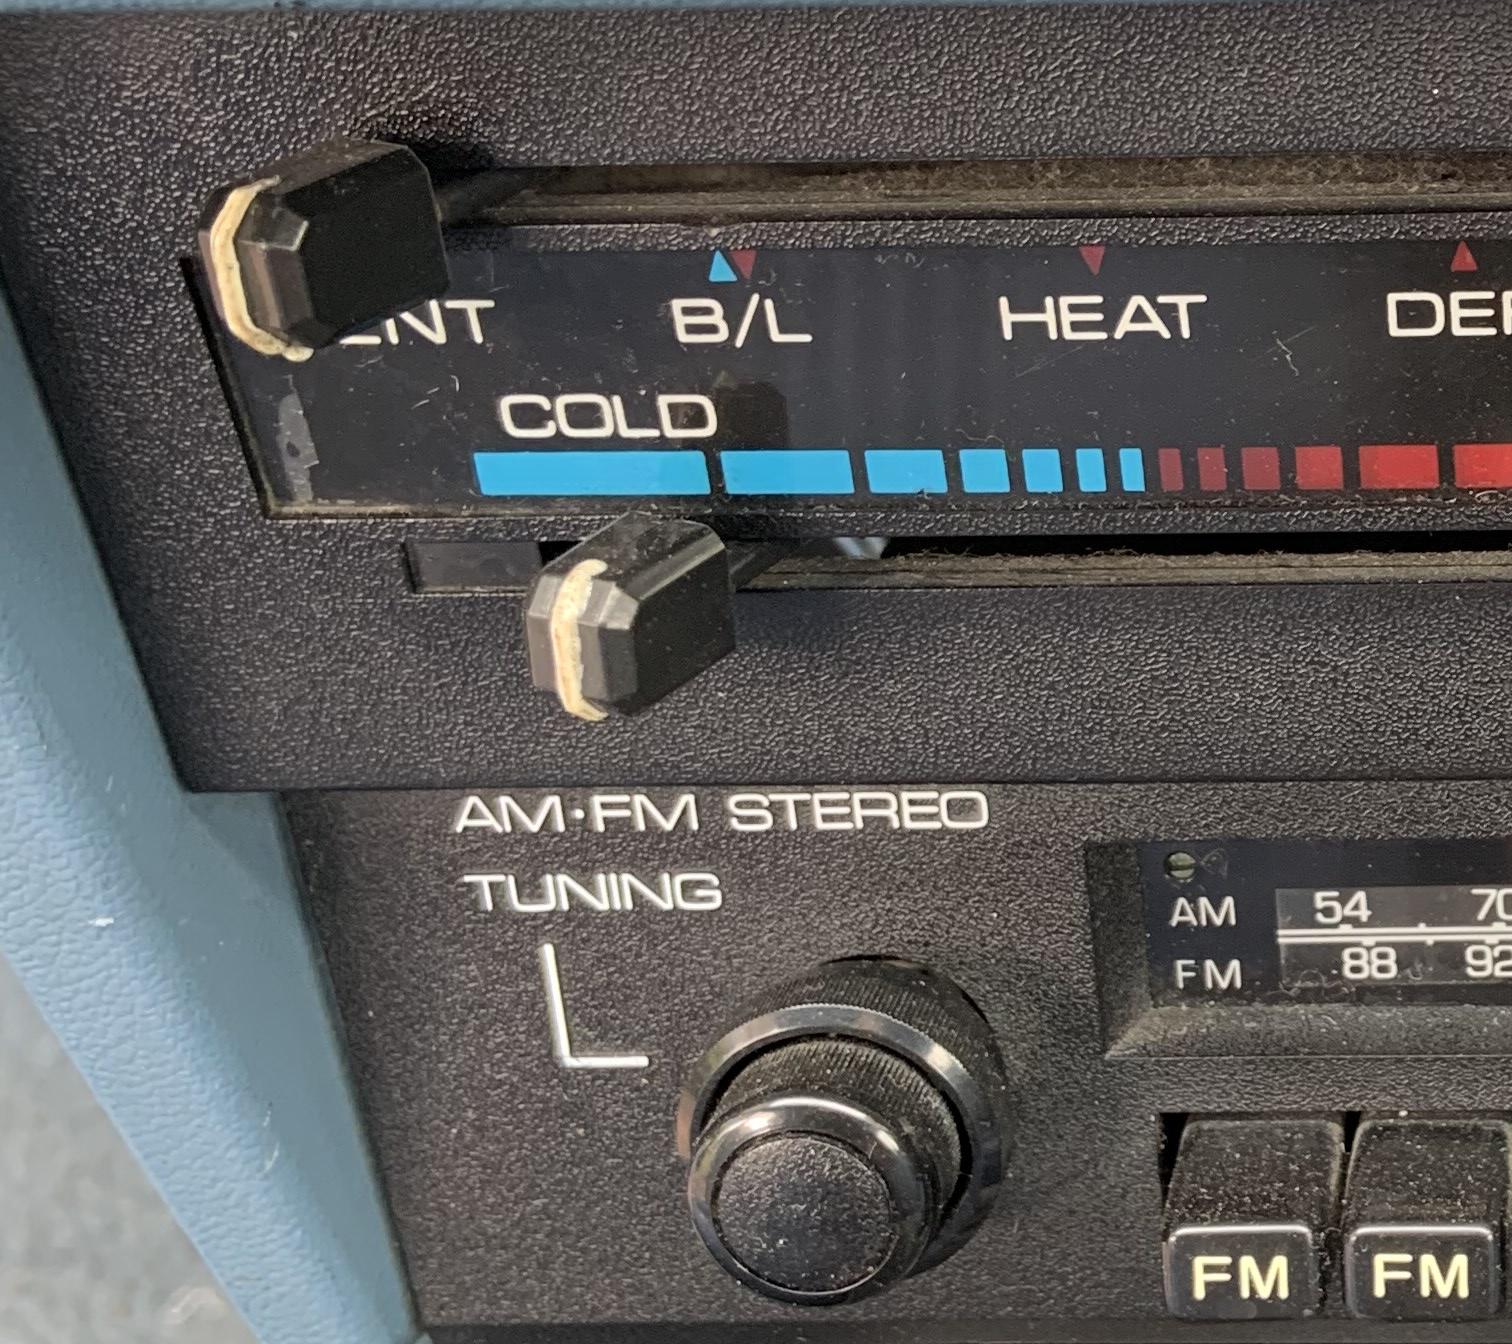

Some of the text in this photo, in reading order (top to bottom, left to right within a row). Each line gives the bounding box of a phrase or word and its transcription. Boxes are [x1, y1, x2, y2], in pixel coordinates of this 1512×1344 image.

[338, 299, 496, 346] NT
[670, 293, 812, 348] B/L
[998, 293, 1207, 342] HEAT
[497, 392, 717, 439] COLD
[729, 791, 990, 830] STEREO
[463, 872, 722, 912] TUNING
[1169, 897, 1237, 928] AM
[1314, 891, 1373, 924] 54
[1176, 960, 1242, 990] FM
[1342, 947, 1398, 980] 88
[1193, 1255, 1289, 1300] FM
[1373, 1253, 1469, 1298] FM
